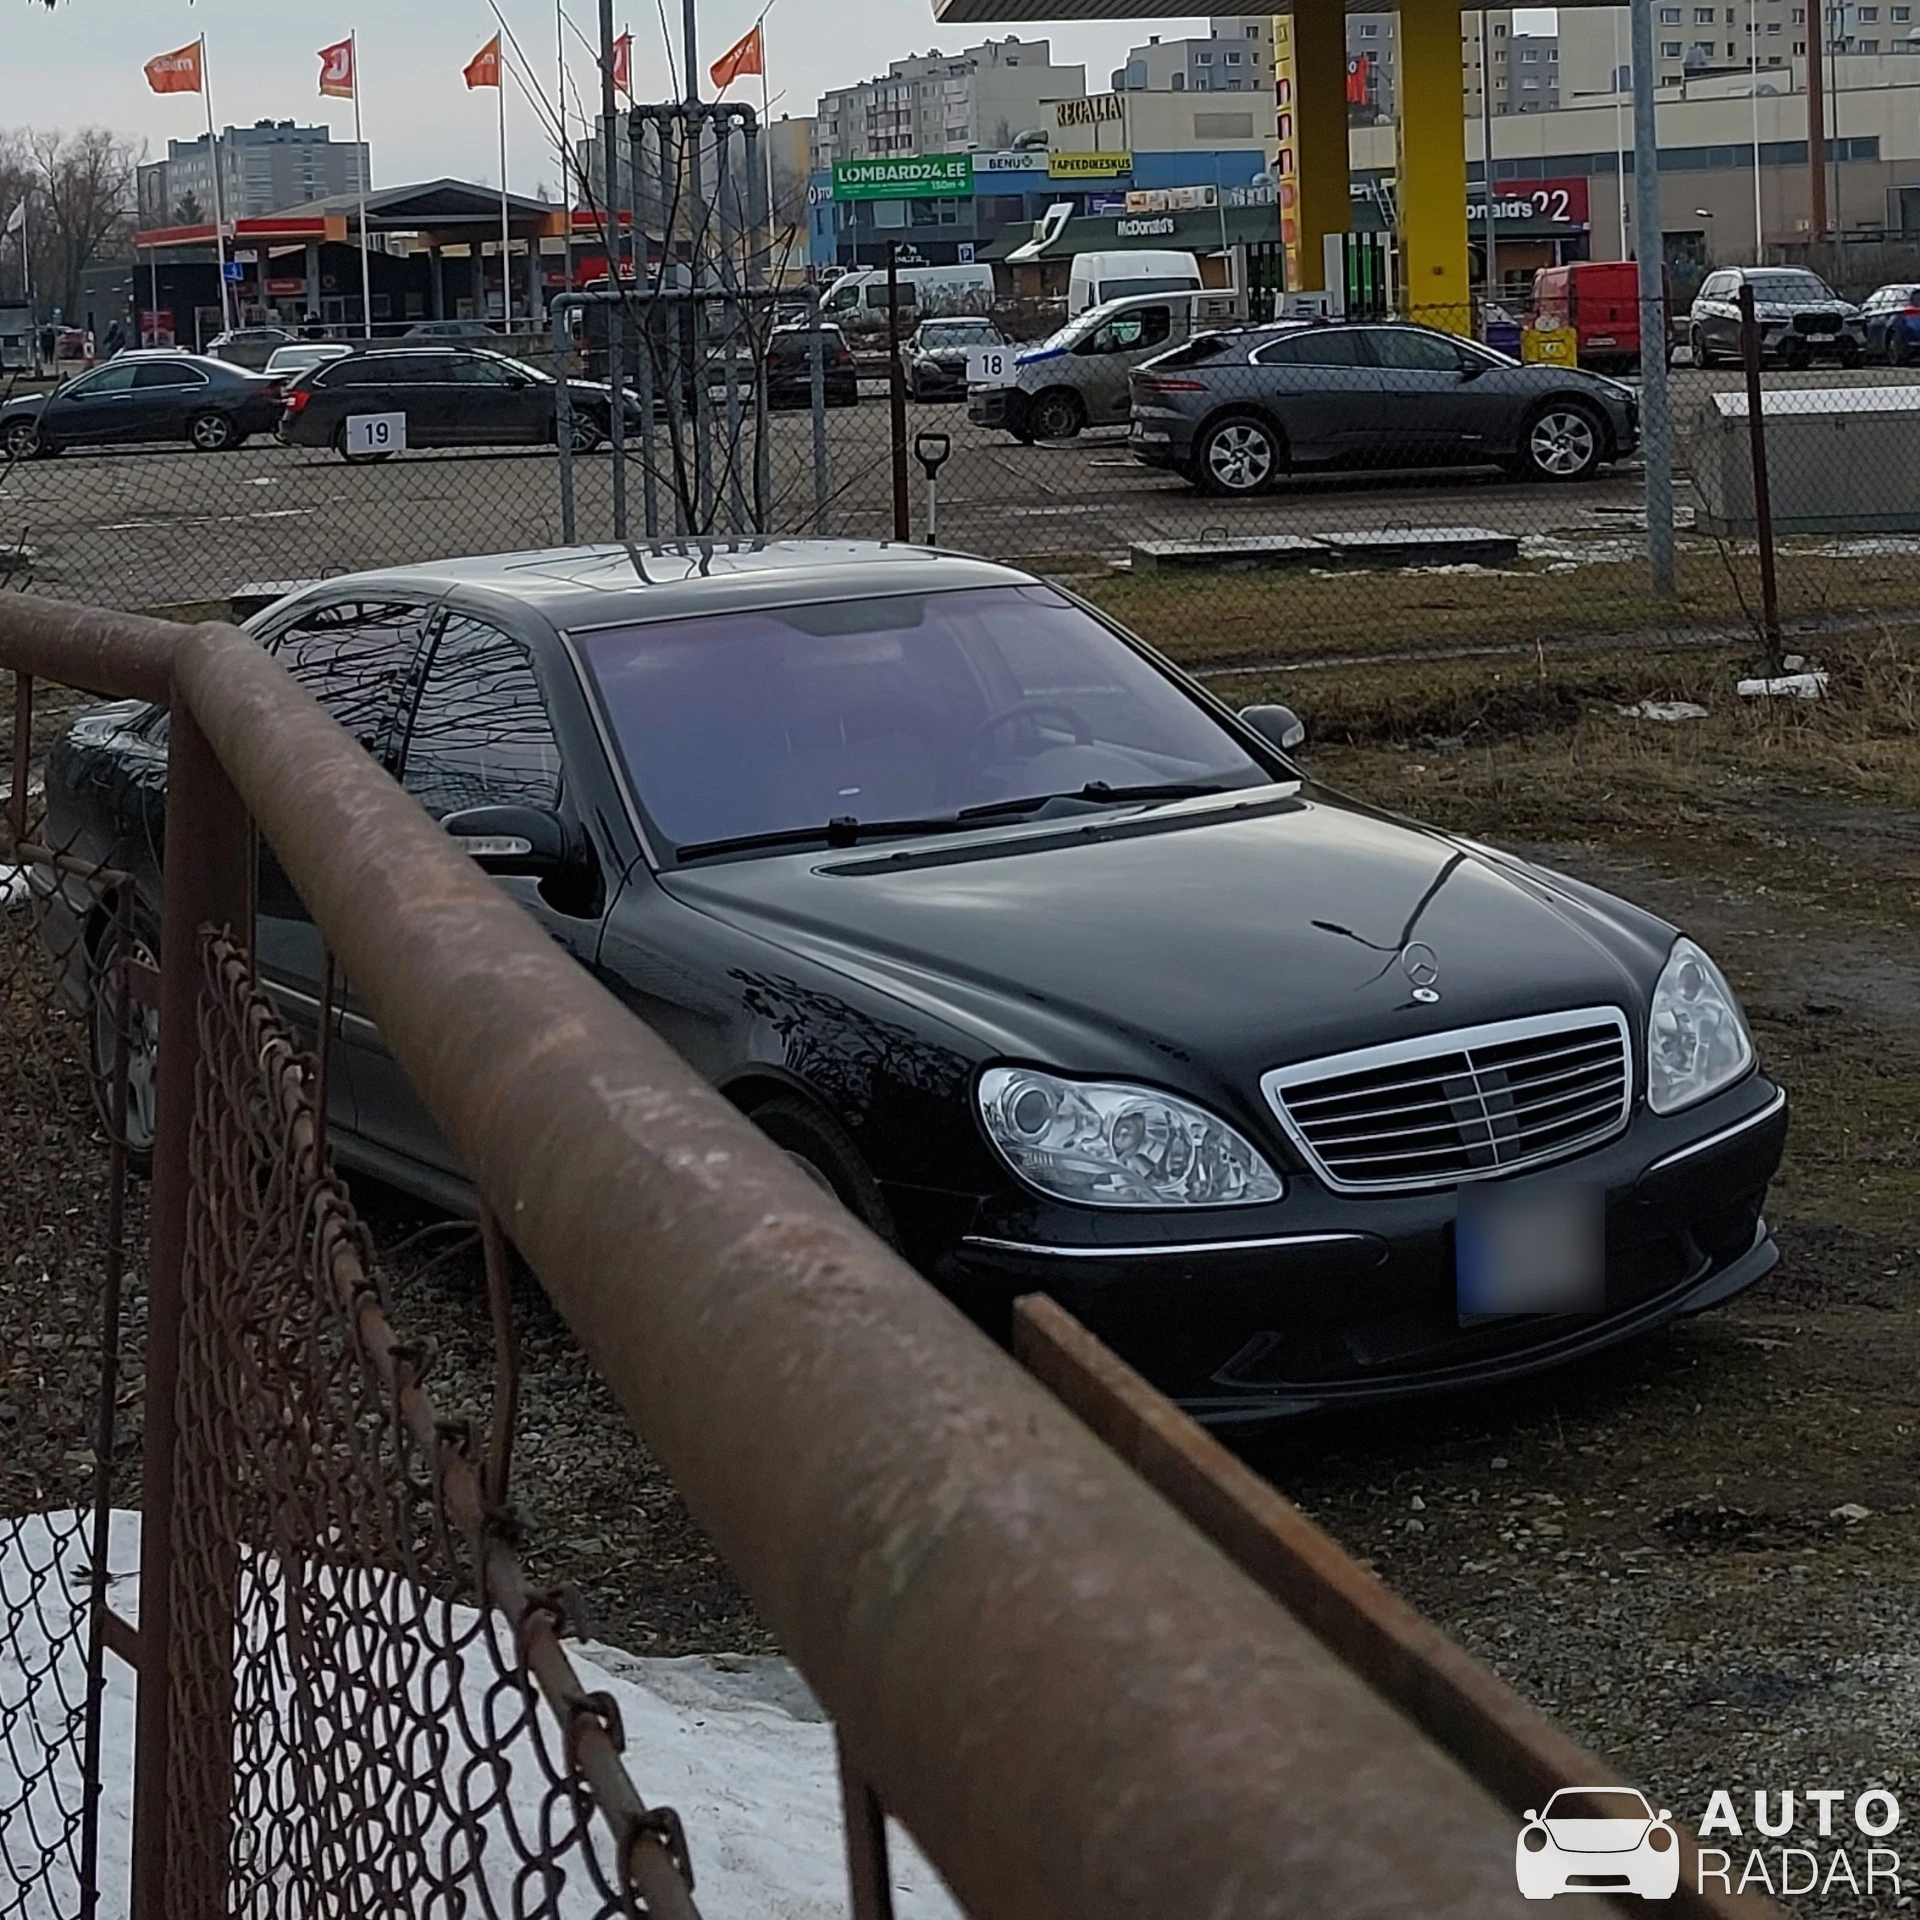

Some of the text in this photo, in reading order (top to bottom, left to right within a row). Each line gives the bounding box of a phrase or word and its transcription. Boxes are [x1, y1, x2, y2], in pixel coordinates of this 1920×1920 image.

[838, 162, 967, 183] LOMBARD24.EE
[988, 157, 1021, 169] BENU
[1466, 202, 1534, 219] onald's
[1117, 217, 1175, 236] McDonald's
[982, 354, 1002, 375] 18
[365, 422, 389, 445] 19
